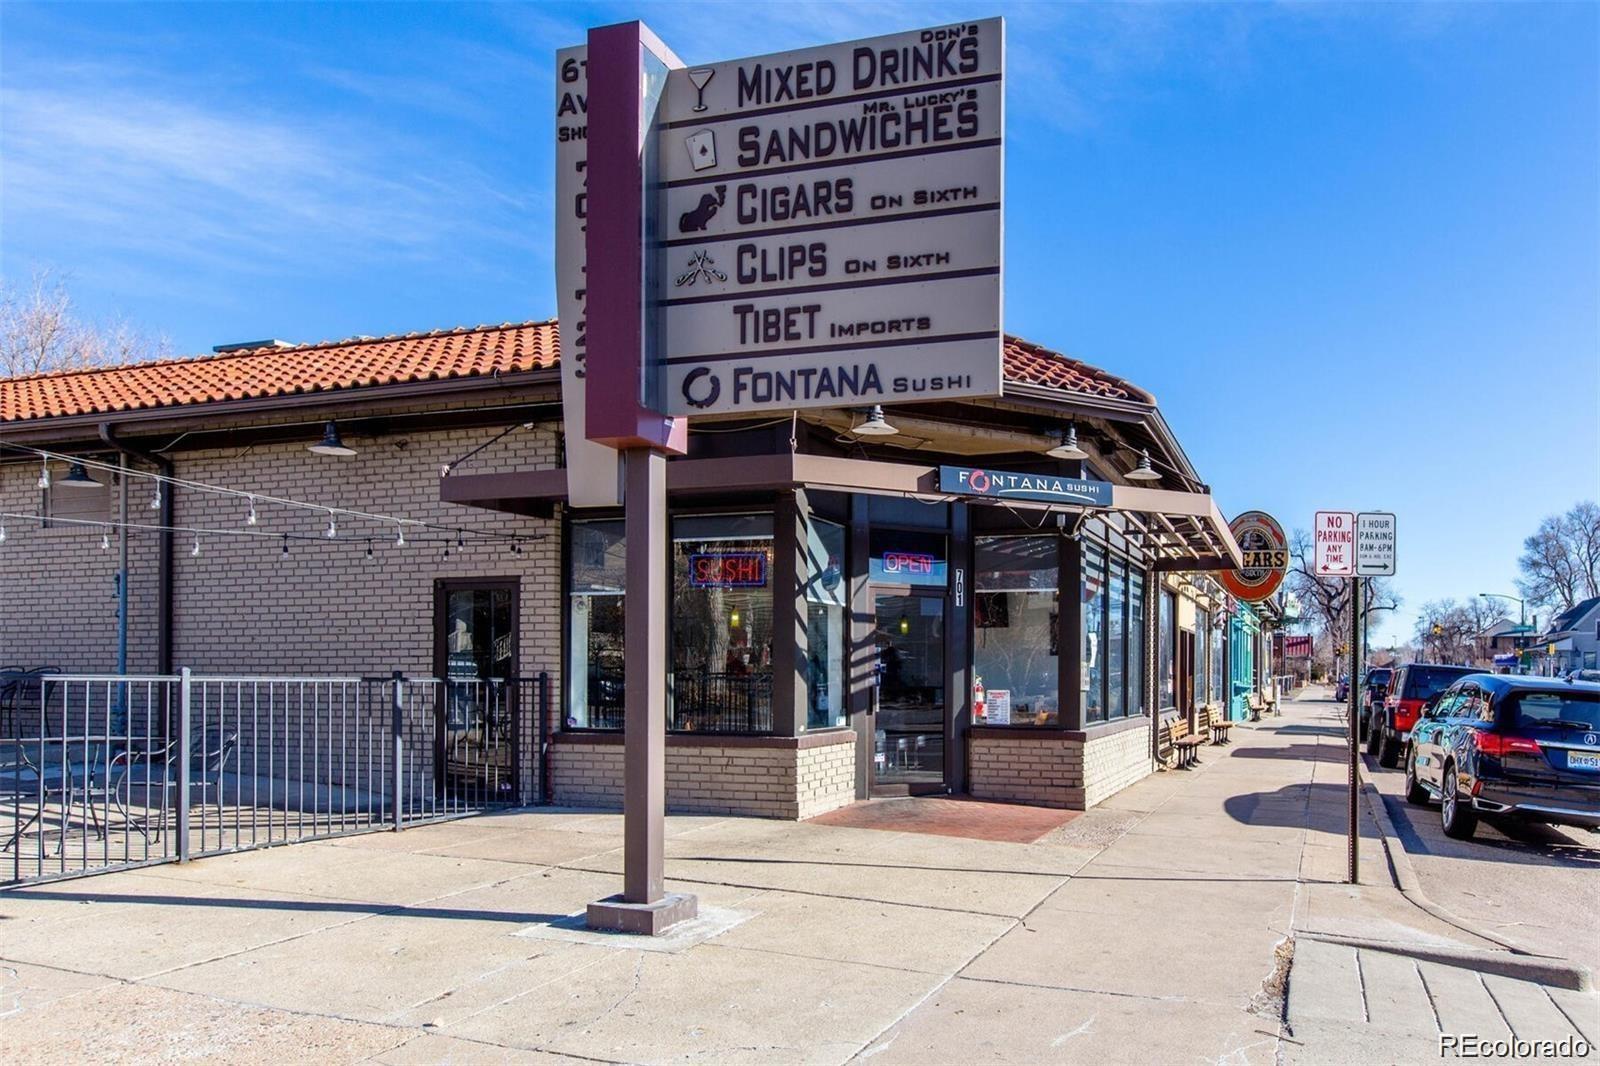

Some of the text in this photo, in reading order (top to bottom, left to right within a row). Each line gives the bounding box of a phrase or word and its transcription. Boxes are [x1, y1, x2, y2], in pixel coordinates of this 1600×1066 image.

[921, 24, 978, 43] DON'S
[738, 37, 978, 108] MIXED DRINKS
[863, 89, 978, 115] MR. LUCKY'S
[738, 101, 978, 168] SANDWICHES
[737, 178, 978, 225] CIGARS ON SIXTH
[737, 242, 950, 285] CLIPS ON SIXTH
[733, 304, 931, 344] TIBET IMPORTS
[733, 363, 971, 404] FONTANA SUSHI
[959, 469, 1100, 494] FONTANA SUSHI
[1327, 516, 1343, 528] NO
[1368, 520, 1390, 528] HOUR
[1317, 531, 1352, 543] PARKING
[1360, 532, 1393, 541] PARKING
[1327, 545, 1343, 553] ANY
[1360, 544, 1393, 552] 8AM-6PM
[886, 554, 932, 574] OPEN
[1243, 551, 1285, 568] GARS
[1325, 554, 1344, 563] TIME
[696, 558, 760, 582] SUSHI
